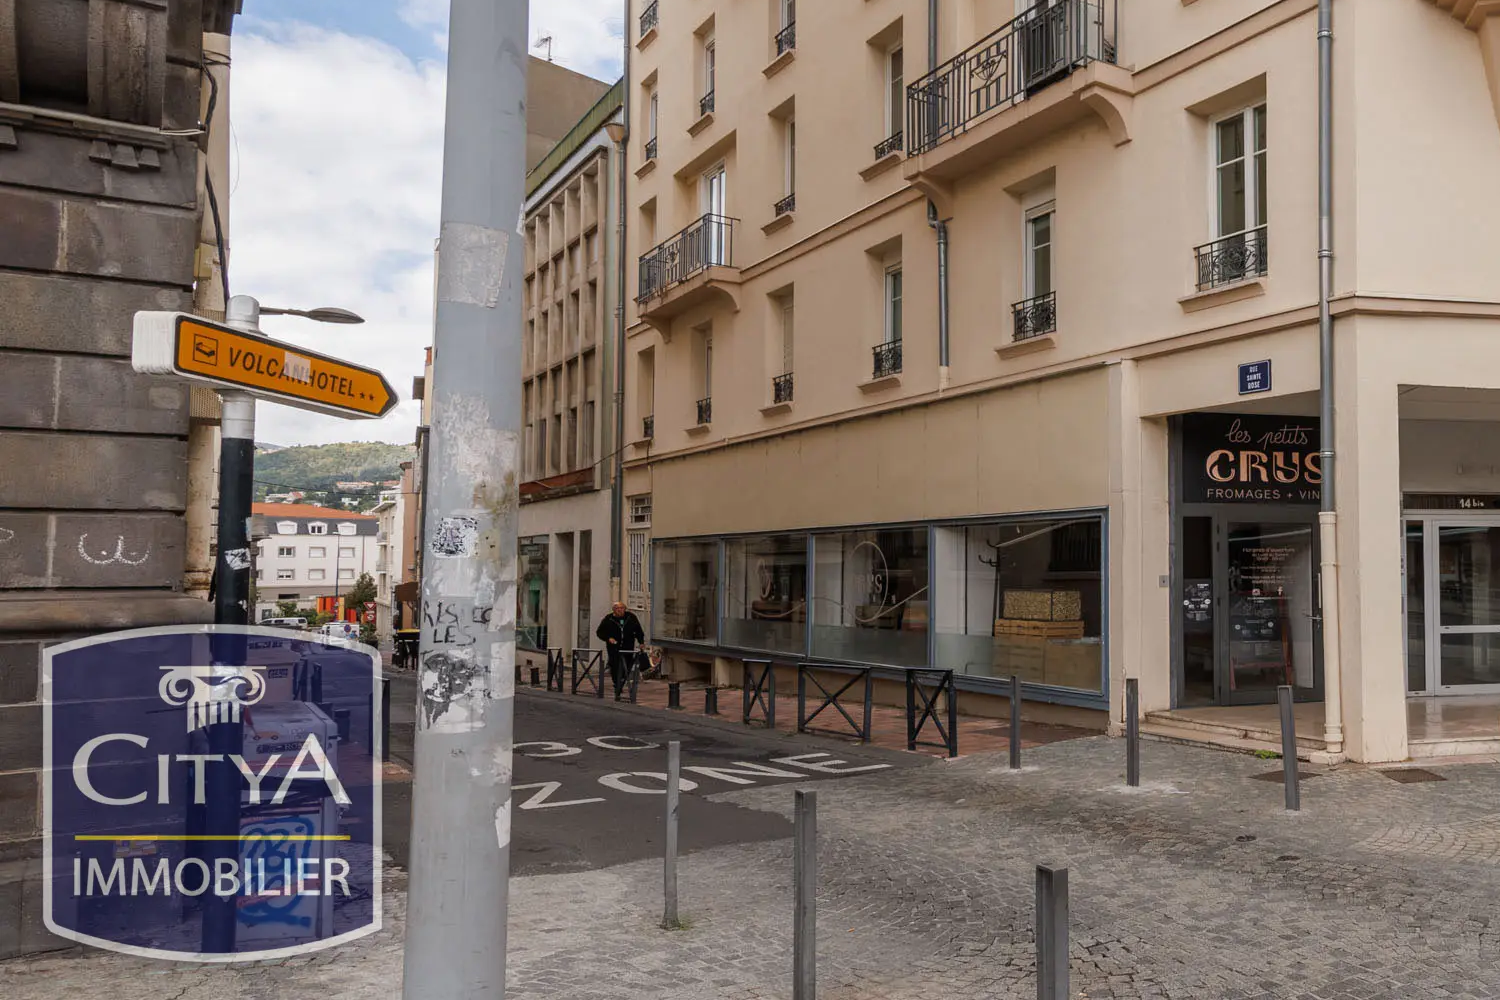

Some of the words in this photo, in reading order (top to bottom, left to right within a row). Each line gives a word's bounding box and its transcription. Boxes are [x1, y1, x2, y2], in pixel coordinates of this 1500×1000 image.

[1249, 365, 1259, 373] RUE
[1246, 373, 1262, 382] SAINTE
[1247, 381, 1261, 390] ROSE
[1225, 418, 1252, 443] les
[1257, 424, 1314, 450] petits
[1205, 449, 1322, 484] CRUS
[1207, 488, 1281, 500] FROMAGES
[1459, 498, 1472, 509] 14
[1472, 499, 1485, 508] bis
[511, 752, 893, 810] ZONE
